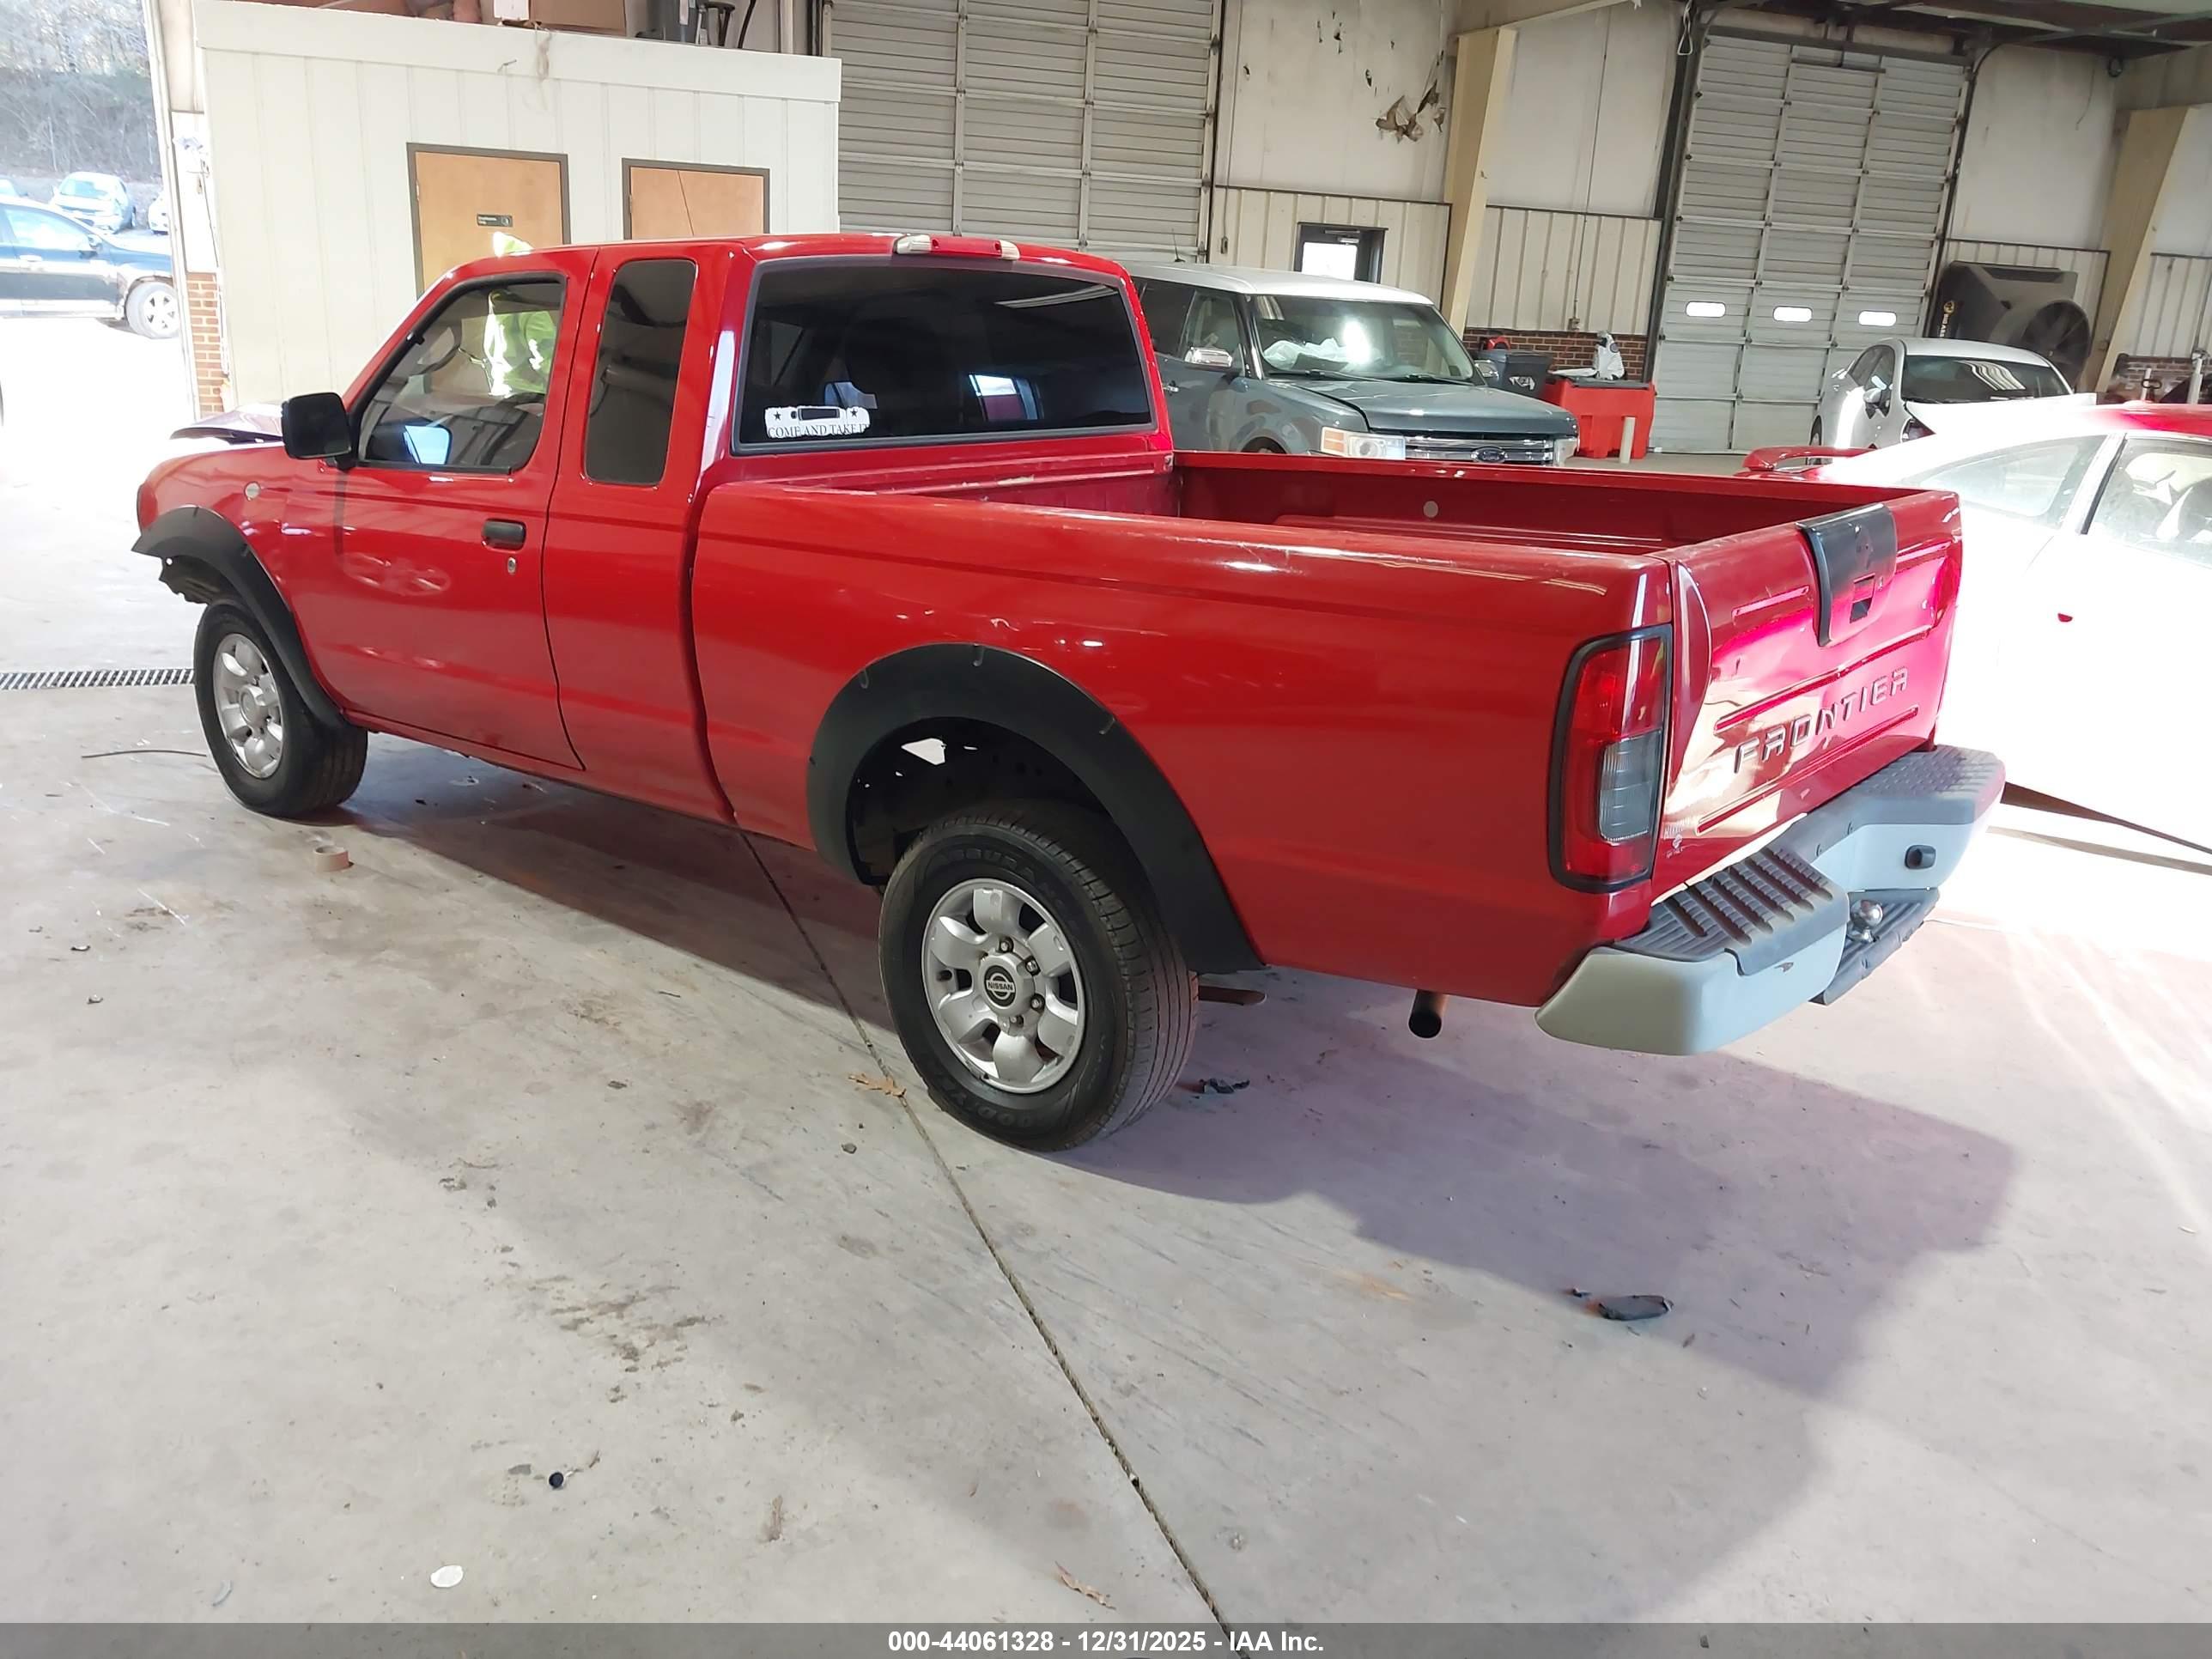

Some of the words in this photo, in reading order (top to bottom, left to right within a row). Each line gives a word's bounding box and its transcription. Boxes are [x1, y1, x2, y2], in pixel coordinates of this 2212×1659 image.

[769, 425, 800, 438] COME
[804, 424, 827, 435] AND
[829, 423, 859, 435] TAKE
[1734, 665, 1909, 773] FRONTIER
[988, 981, 1013, 991] NISSAN
